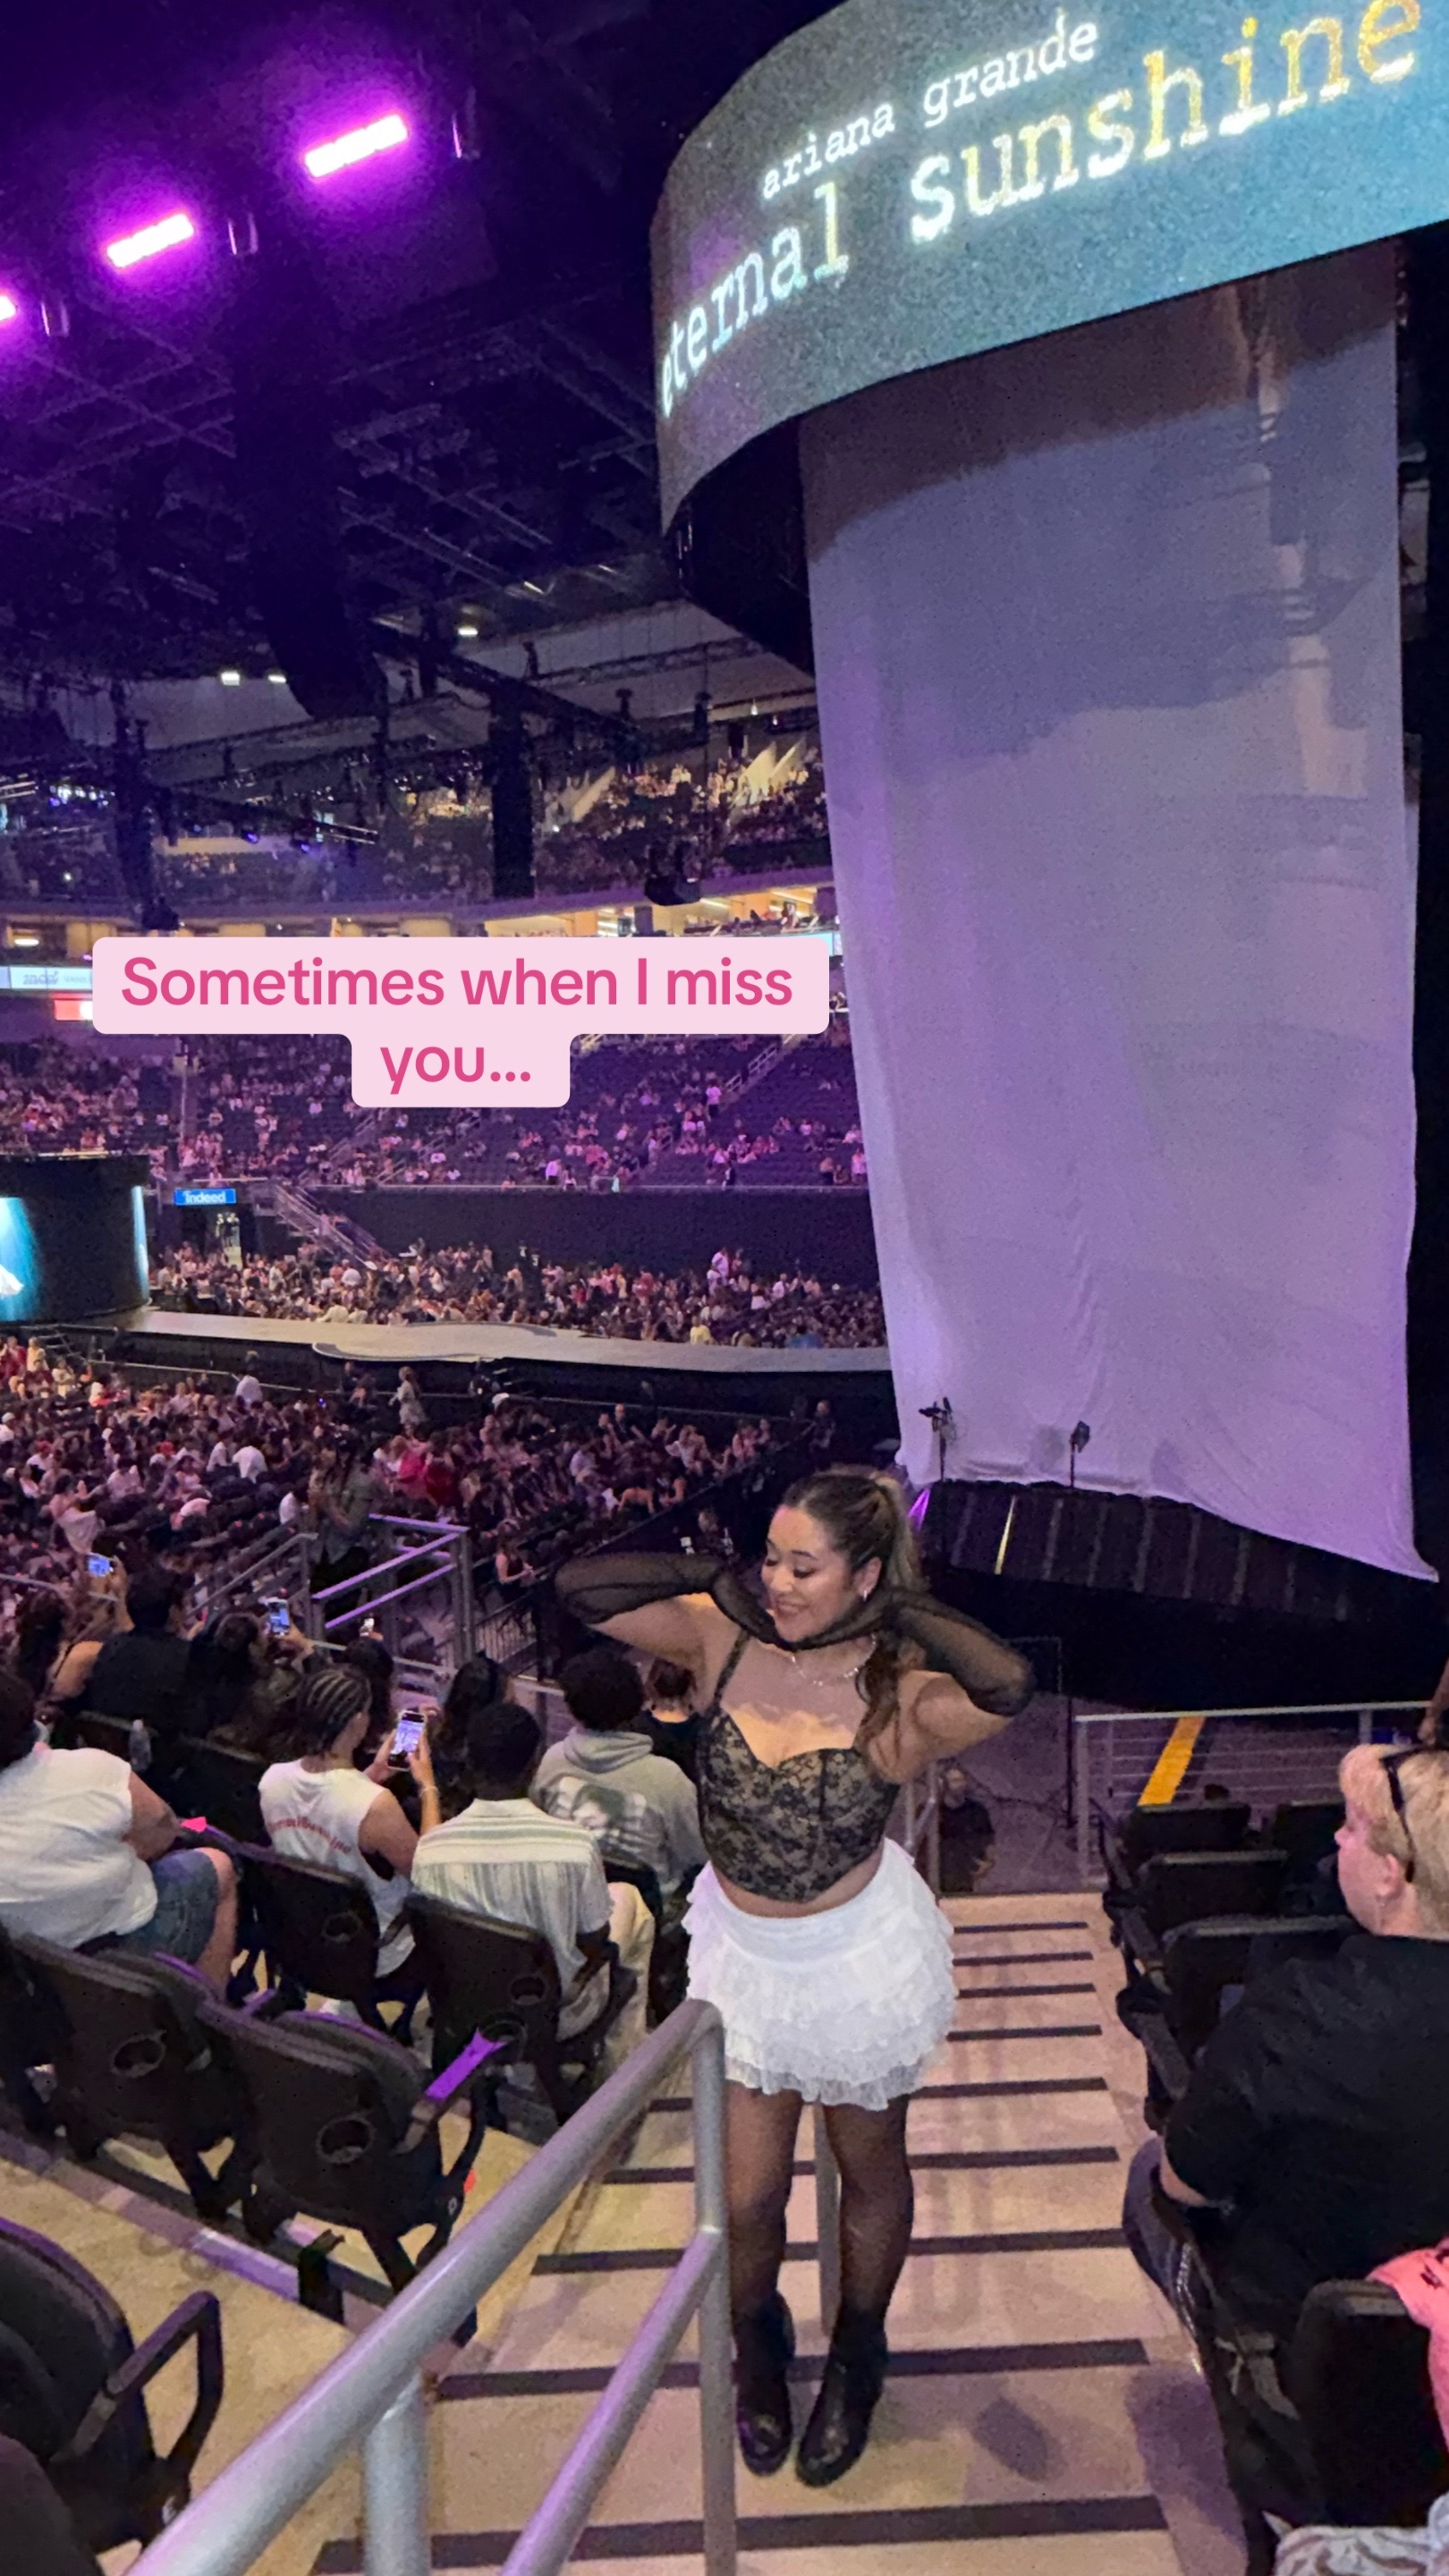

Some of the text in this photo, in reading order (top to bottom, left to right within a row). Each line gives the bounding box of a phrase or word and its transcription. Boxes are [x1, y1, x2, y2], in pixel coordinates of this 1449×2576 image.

[661, 0, 1421, 419] eternal sunshine
[762, 7, 1098, 199] ariana grande
